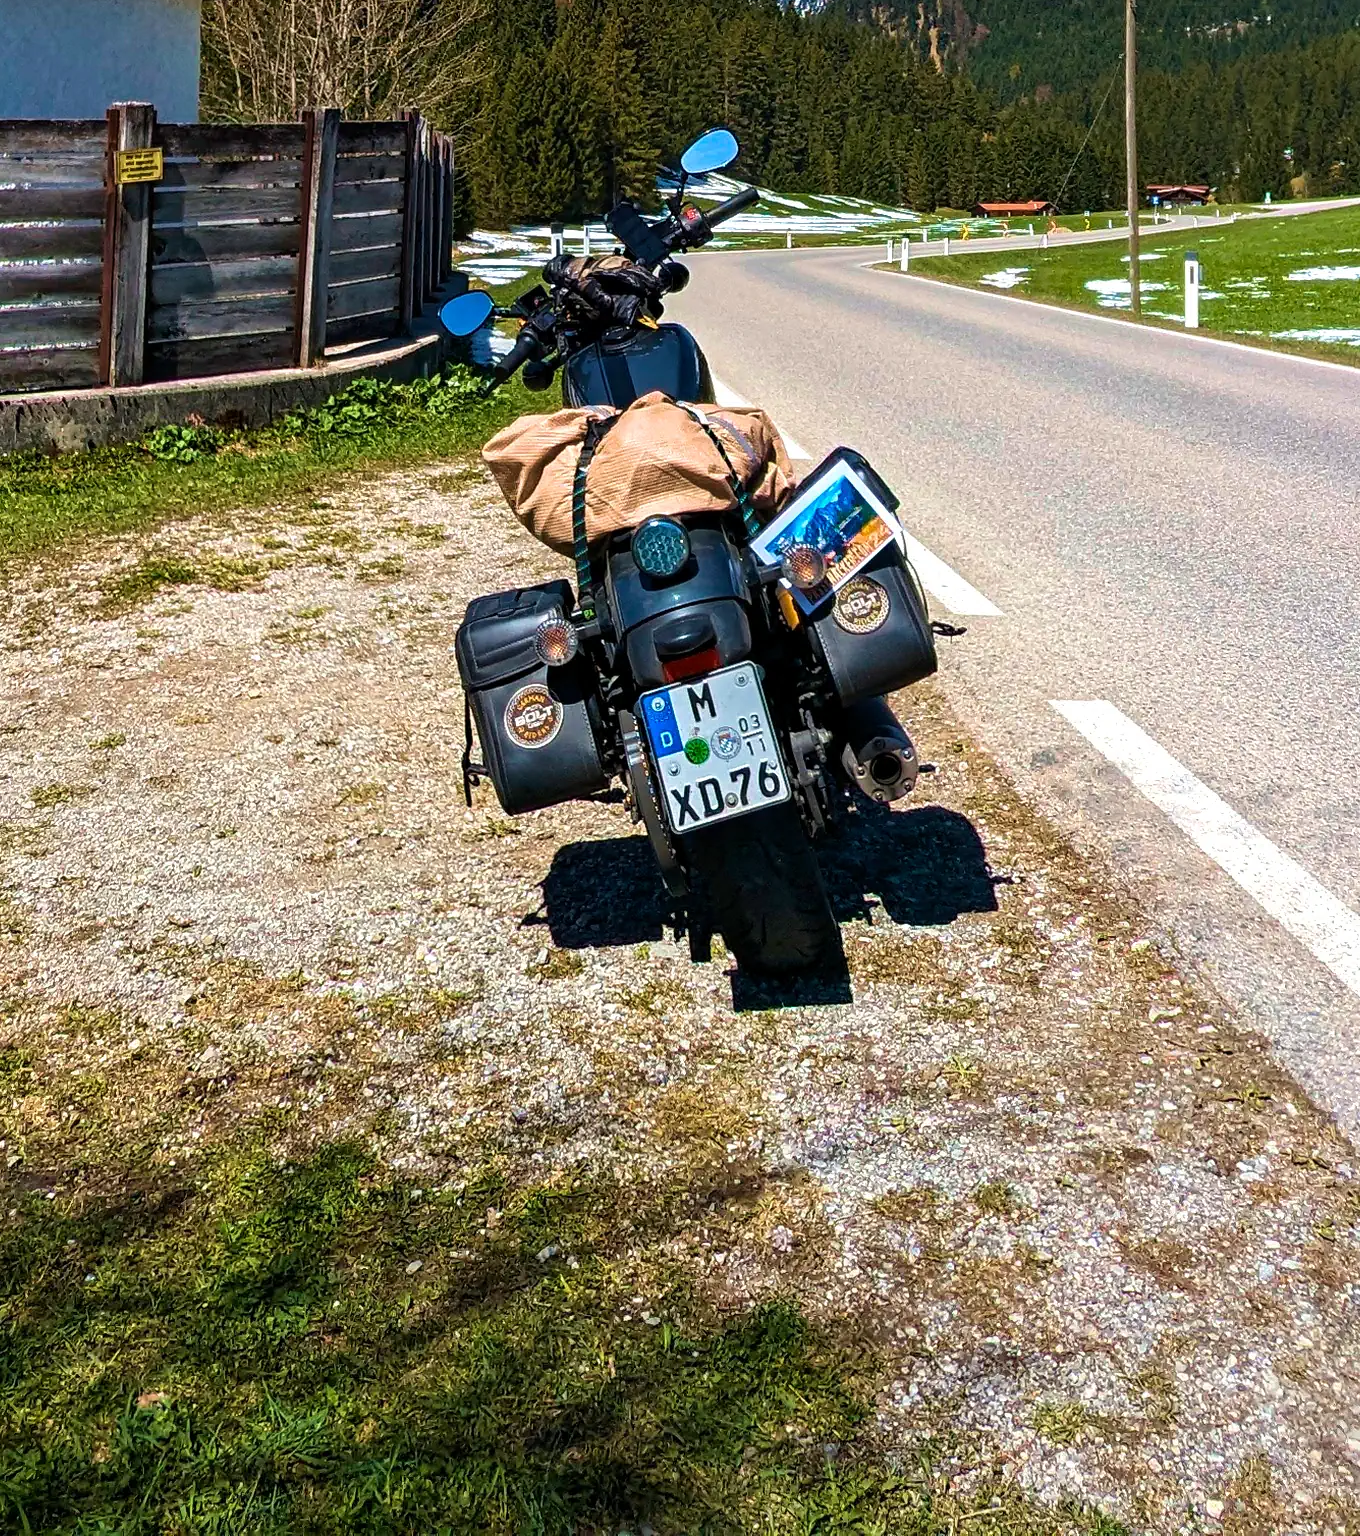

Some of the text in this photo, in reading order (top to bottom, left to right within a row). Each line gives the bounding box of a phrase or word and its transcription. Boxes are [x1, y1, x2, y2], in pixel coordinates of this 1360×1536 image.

[841, 592, 877, 615] BOLT
[687, 683, 717, 722] M
[515, 705, 553, 727] BOLT
[739, 714, 761, 732] 03
[660, 731, 674, 749] D
[746, 735, 767, 756] 11
[671, 760, 780, 826] XD 76
